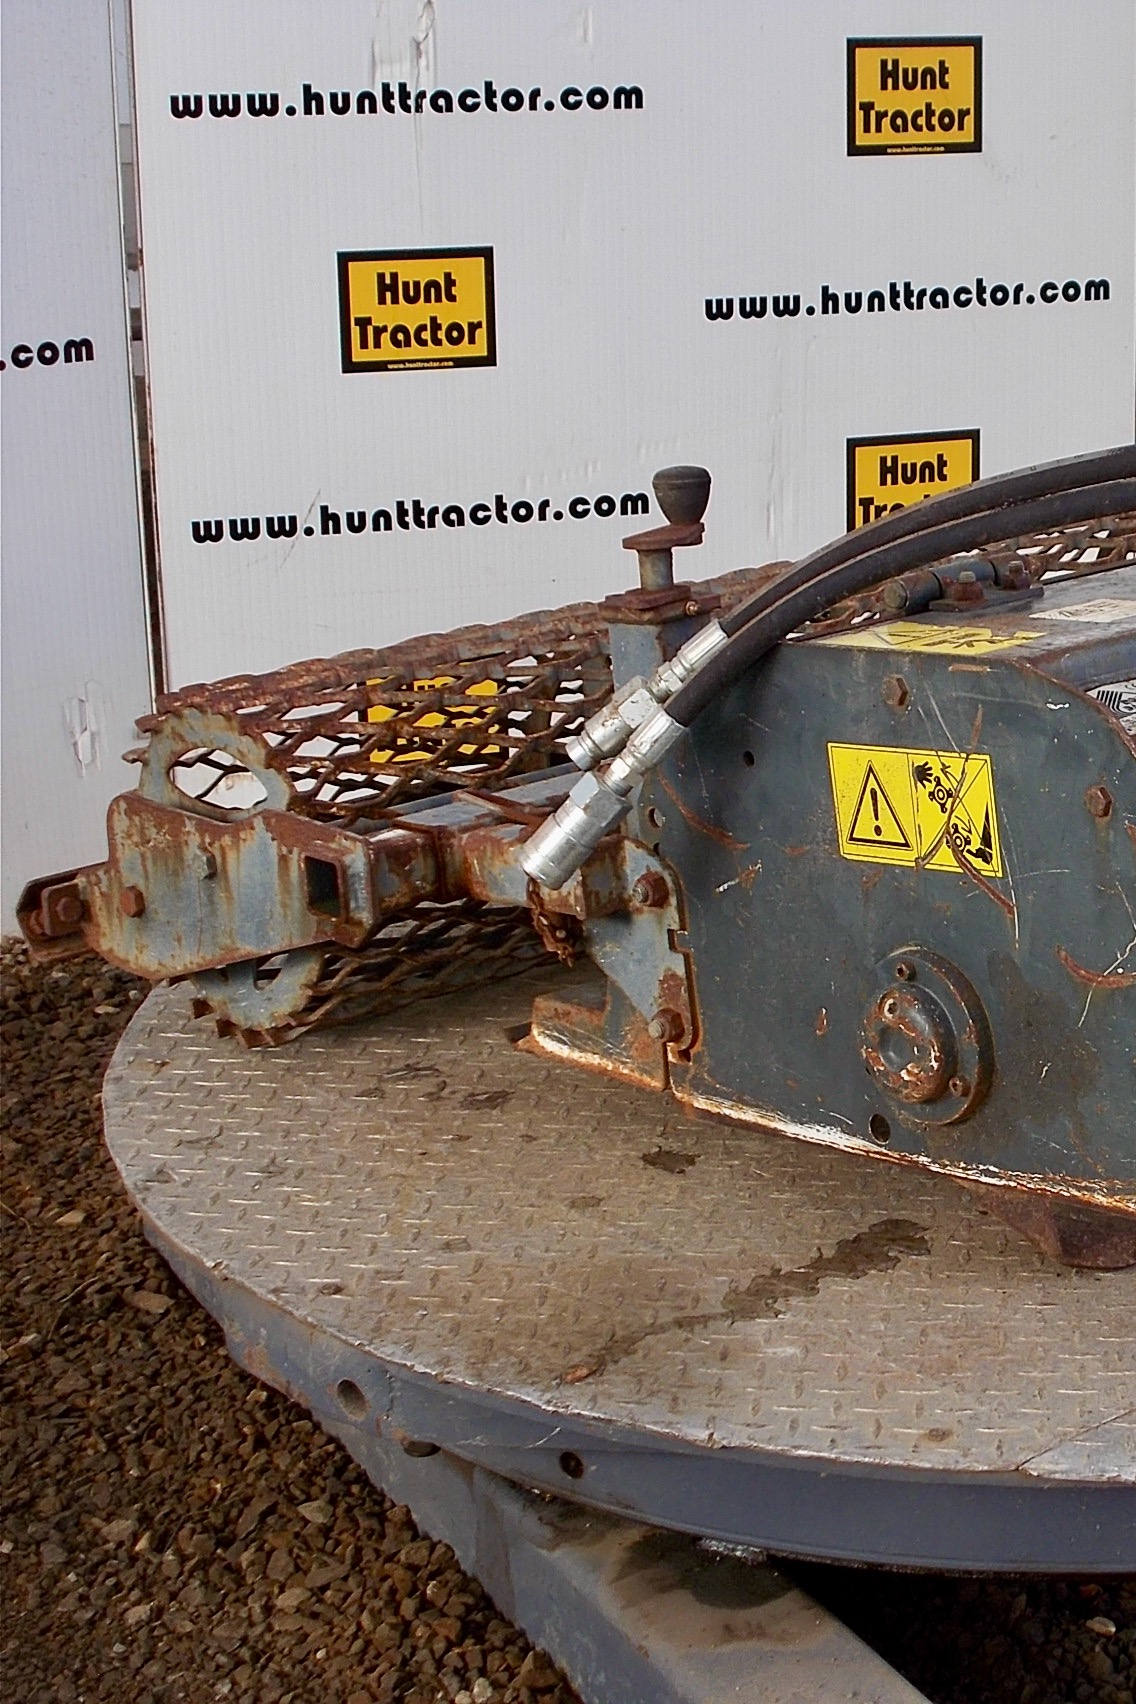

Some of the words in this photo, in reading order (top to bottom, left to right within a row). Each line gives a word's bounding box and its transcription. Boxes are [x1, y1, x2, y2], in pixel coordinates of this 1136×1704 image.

[880, 59, 949, 91] Hunt
[171, 81, 643, 118] www.hunttractor.com
[859, 101, 970, 133] Tractor
[377, 272, 457, 305] Hunt
[705, 278, 1109, 320] www.hunttractor.com
[354, 316, 482, 349] Tractor
[880, 454, 947, 486] Hunt
[192, 493, 651, 543] www.hunttractor.com
